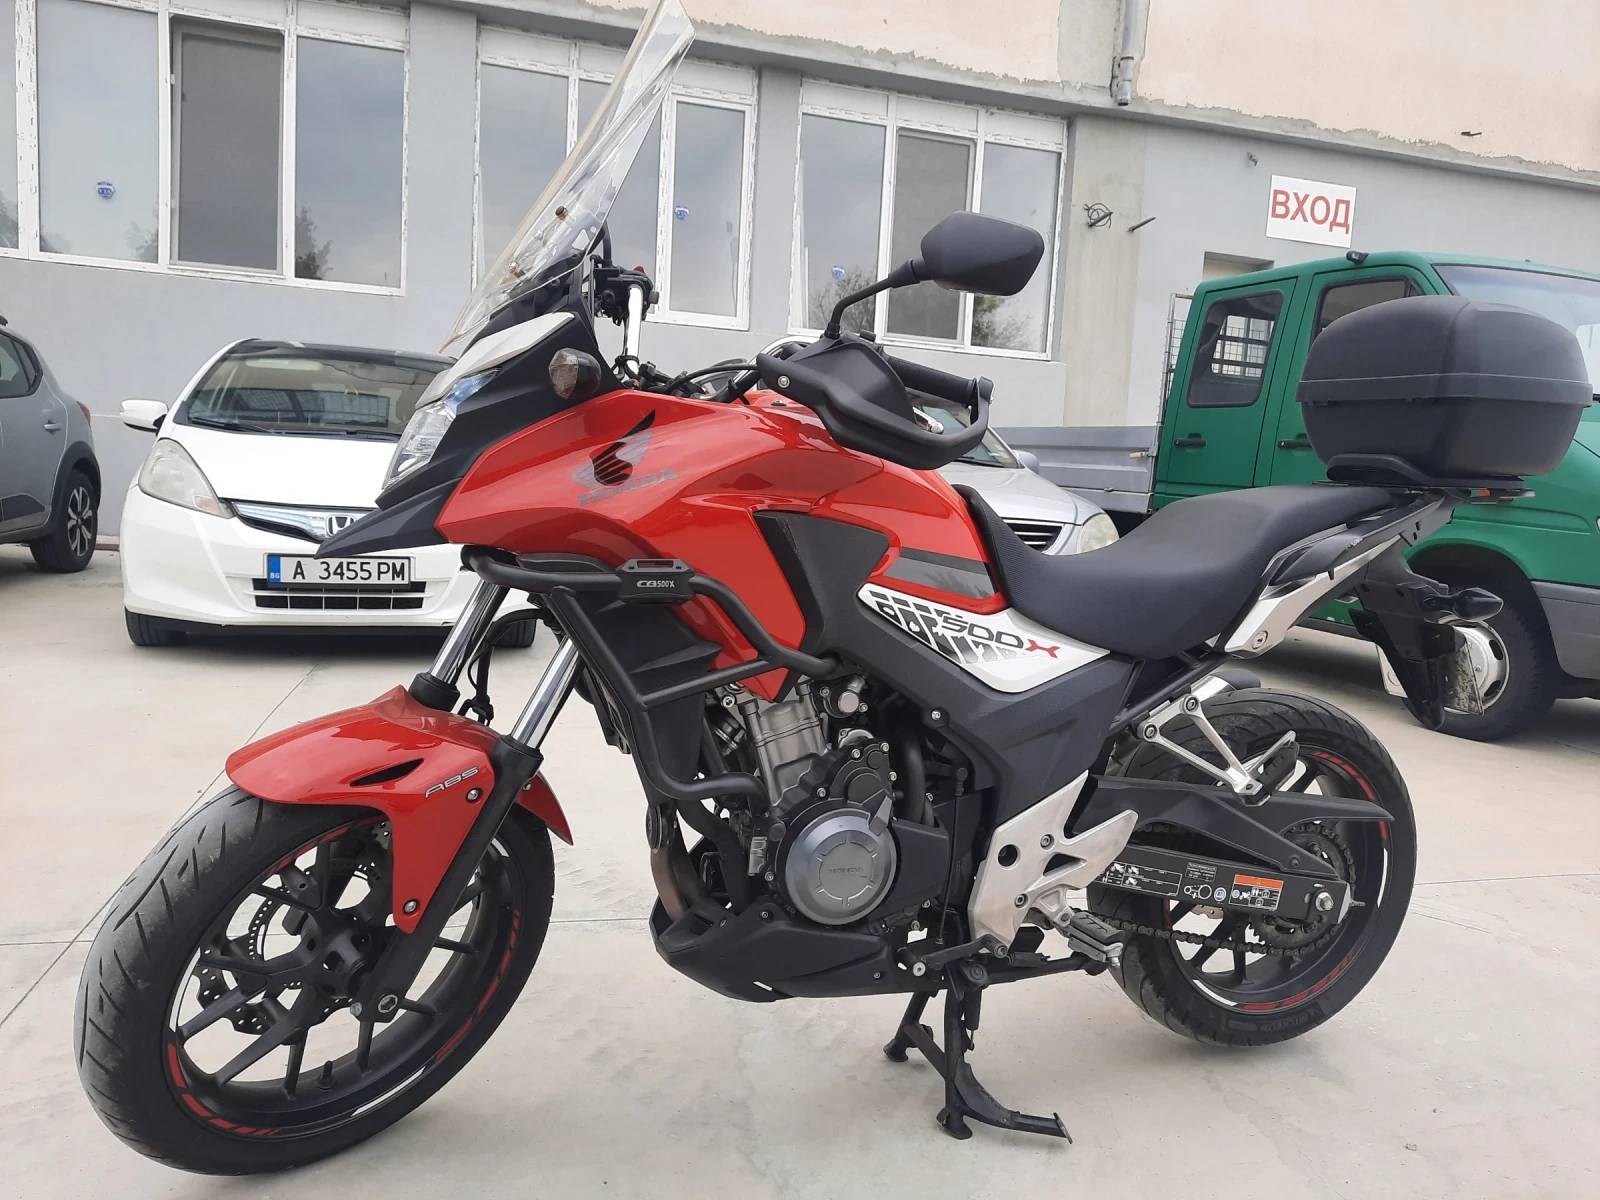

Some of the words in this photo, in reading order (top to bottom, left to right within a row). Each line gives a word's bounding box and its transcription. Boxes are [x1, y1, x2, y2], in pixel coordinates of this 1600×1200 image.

[1271, 188, 1351, 235] ВХОД
[577, 468, 681, 507] HONDA
[292, 560, 306, 580] A
[318, 561, 373, 581] 3455
[425, 766, 479, 799] ABS
